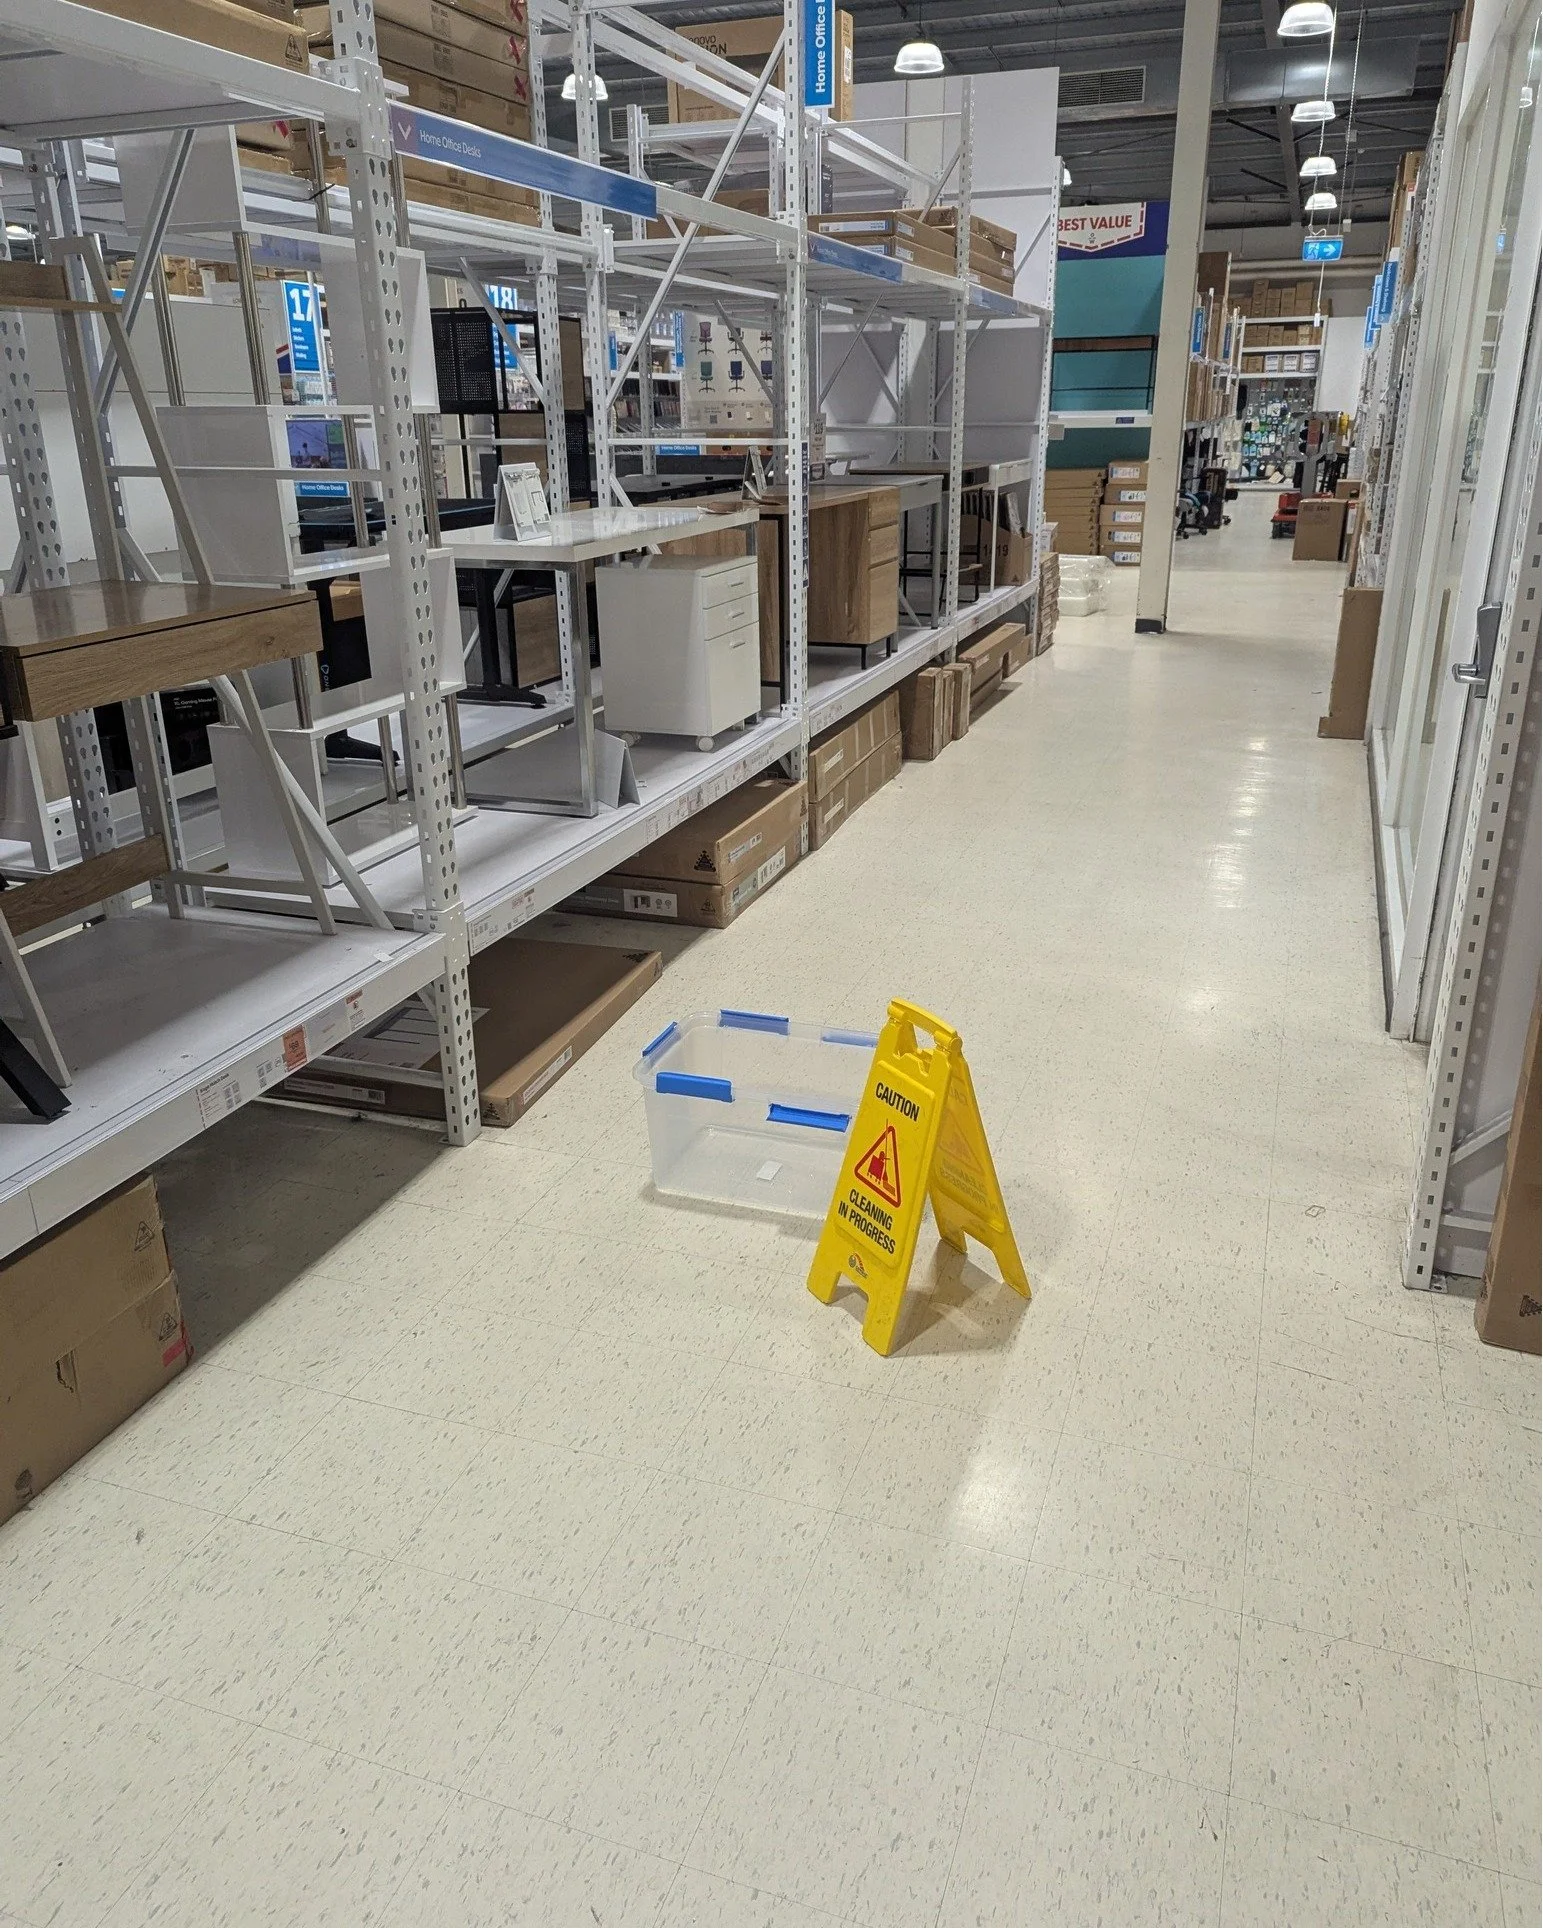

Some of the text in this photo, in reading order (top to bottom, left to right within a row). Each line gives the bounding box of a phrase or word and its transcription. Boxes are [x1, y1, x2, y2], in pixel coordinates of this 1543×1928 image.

[815, 5, 825, 48] Office
[815, 51, 825, 93] Home
[420, 130, 482, 158] Home Office Desks
[1057, 214, 1132, 232] BEST VALUE
[289, 287, 316, 322] 17
[876, 1082, 920, 1122] CAUTION
[838, 1200, 896, 1255] IN PROGRESS
[849, 1188, 893, 1231] CLEANING
